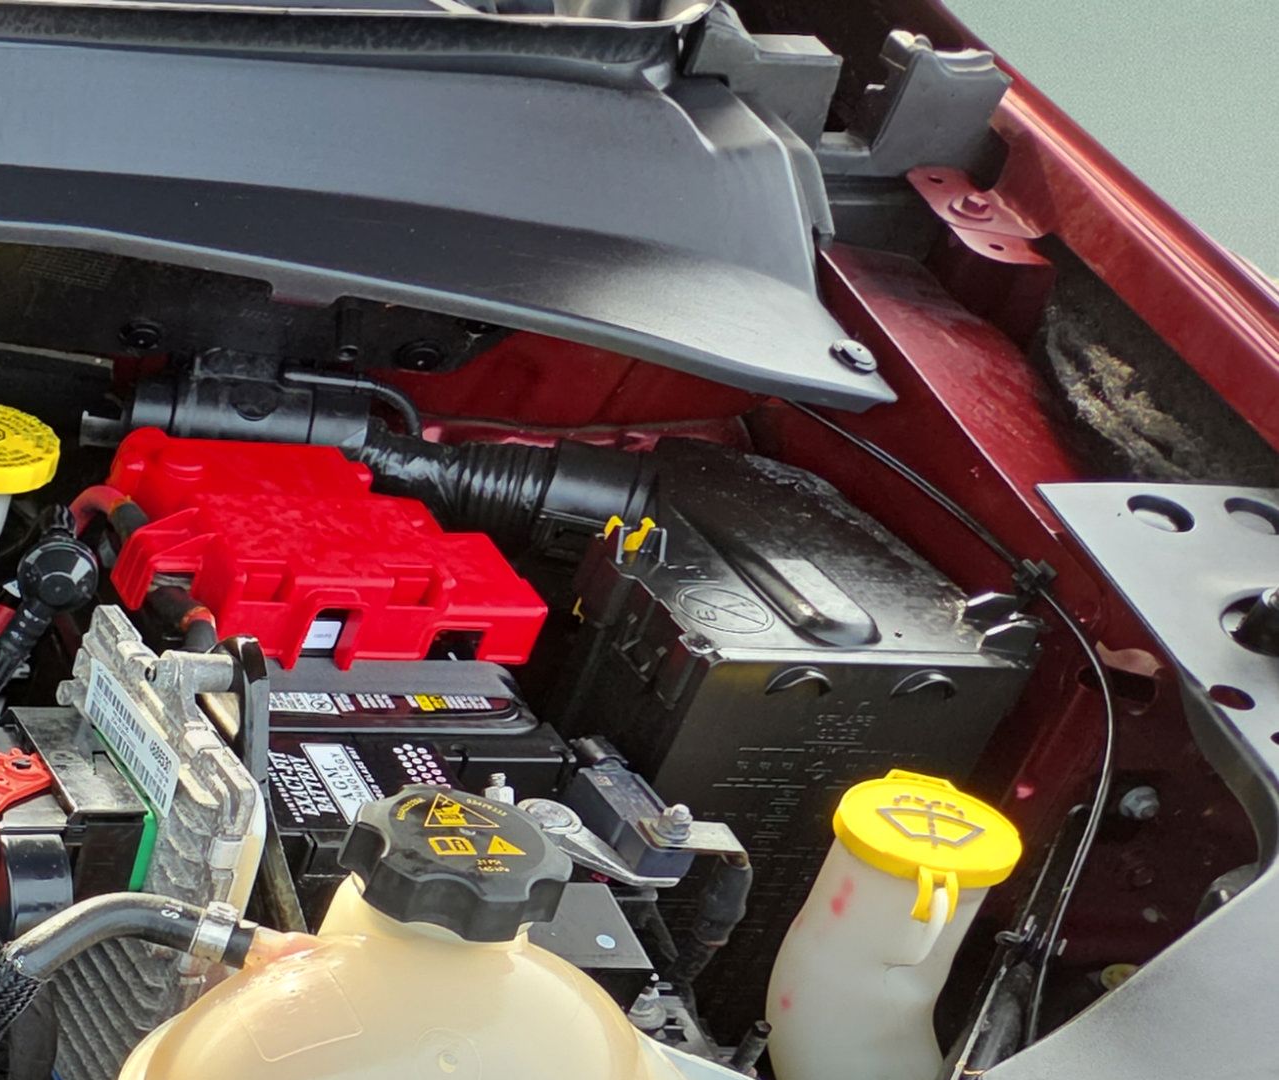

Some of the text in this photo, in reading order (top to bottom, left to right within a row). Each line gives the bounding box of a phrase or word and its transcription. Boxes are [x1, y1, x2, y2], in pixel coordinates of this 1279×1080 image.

[267, 749, 321, 817] EXACT-FIT
[286, 754, 339, 814] BATTERY
[321, 764, 357, 802] AGM
